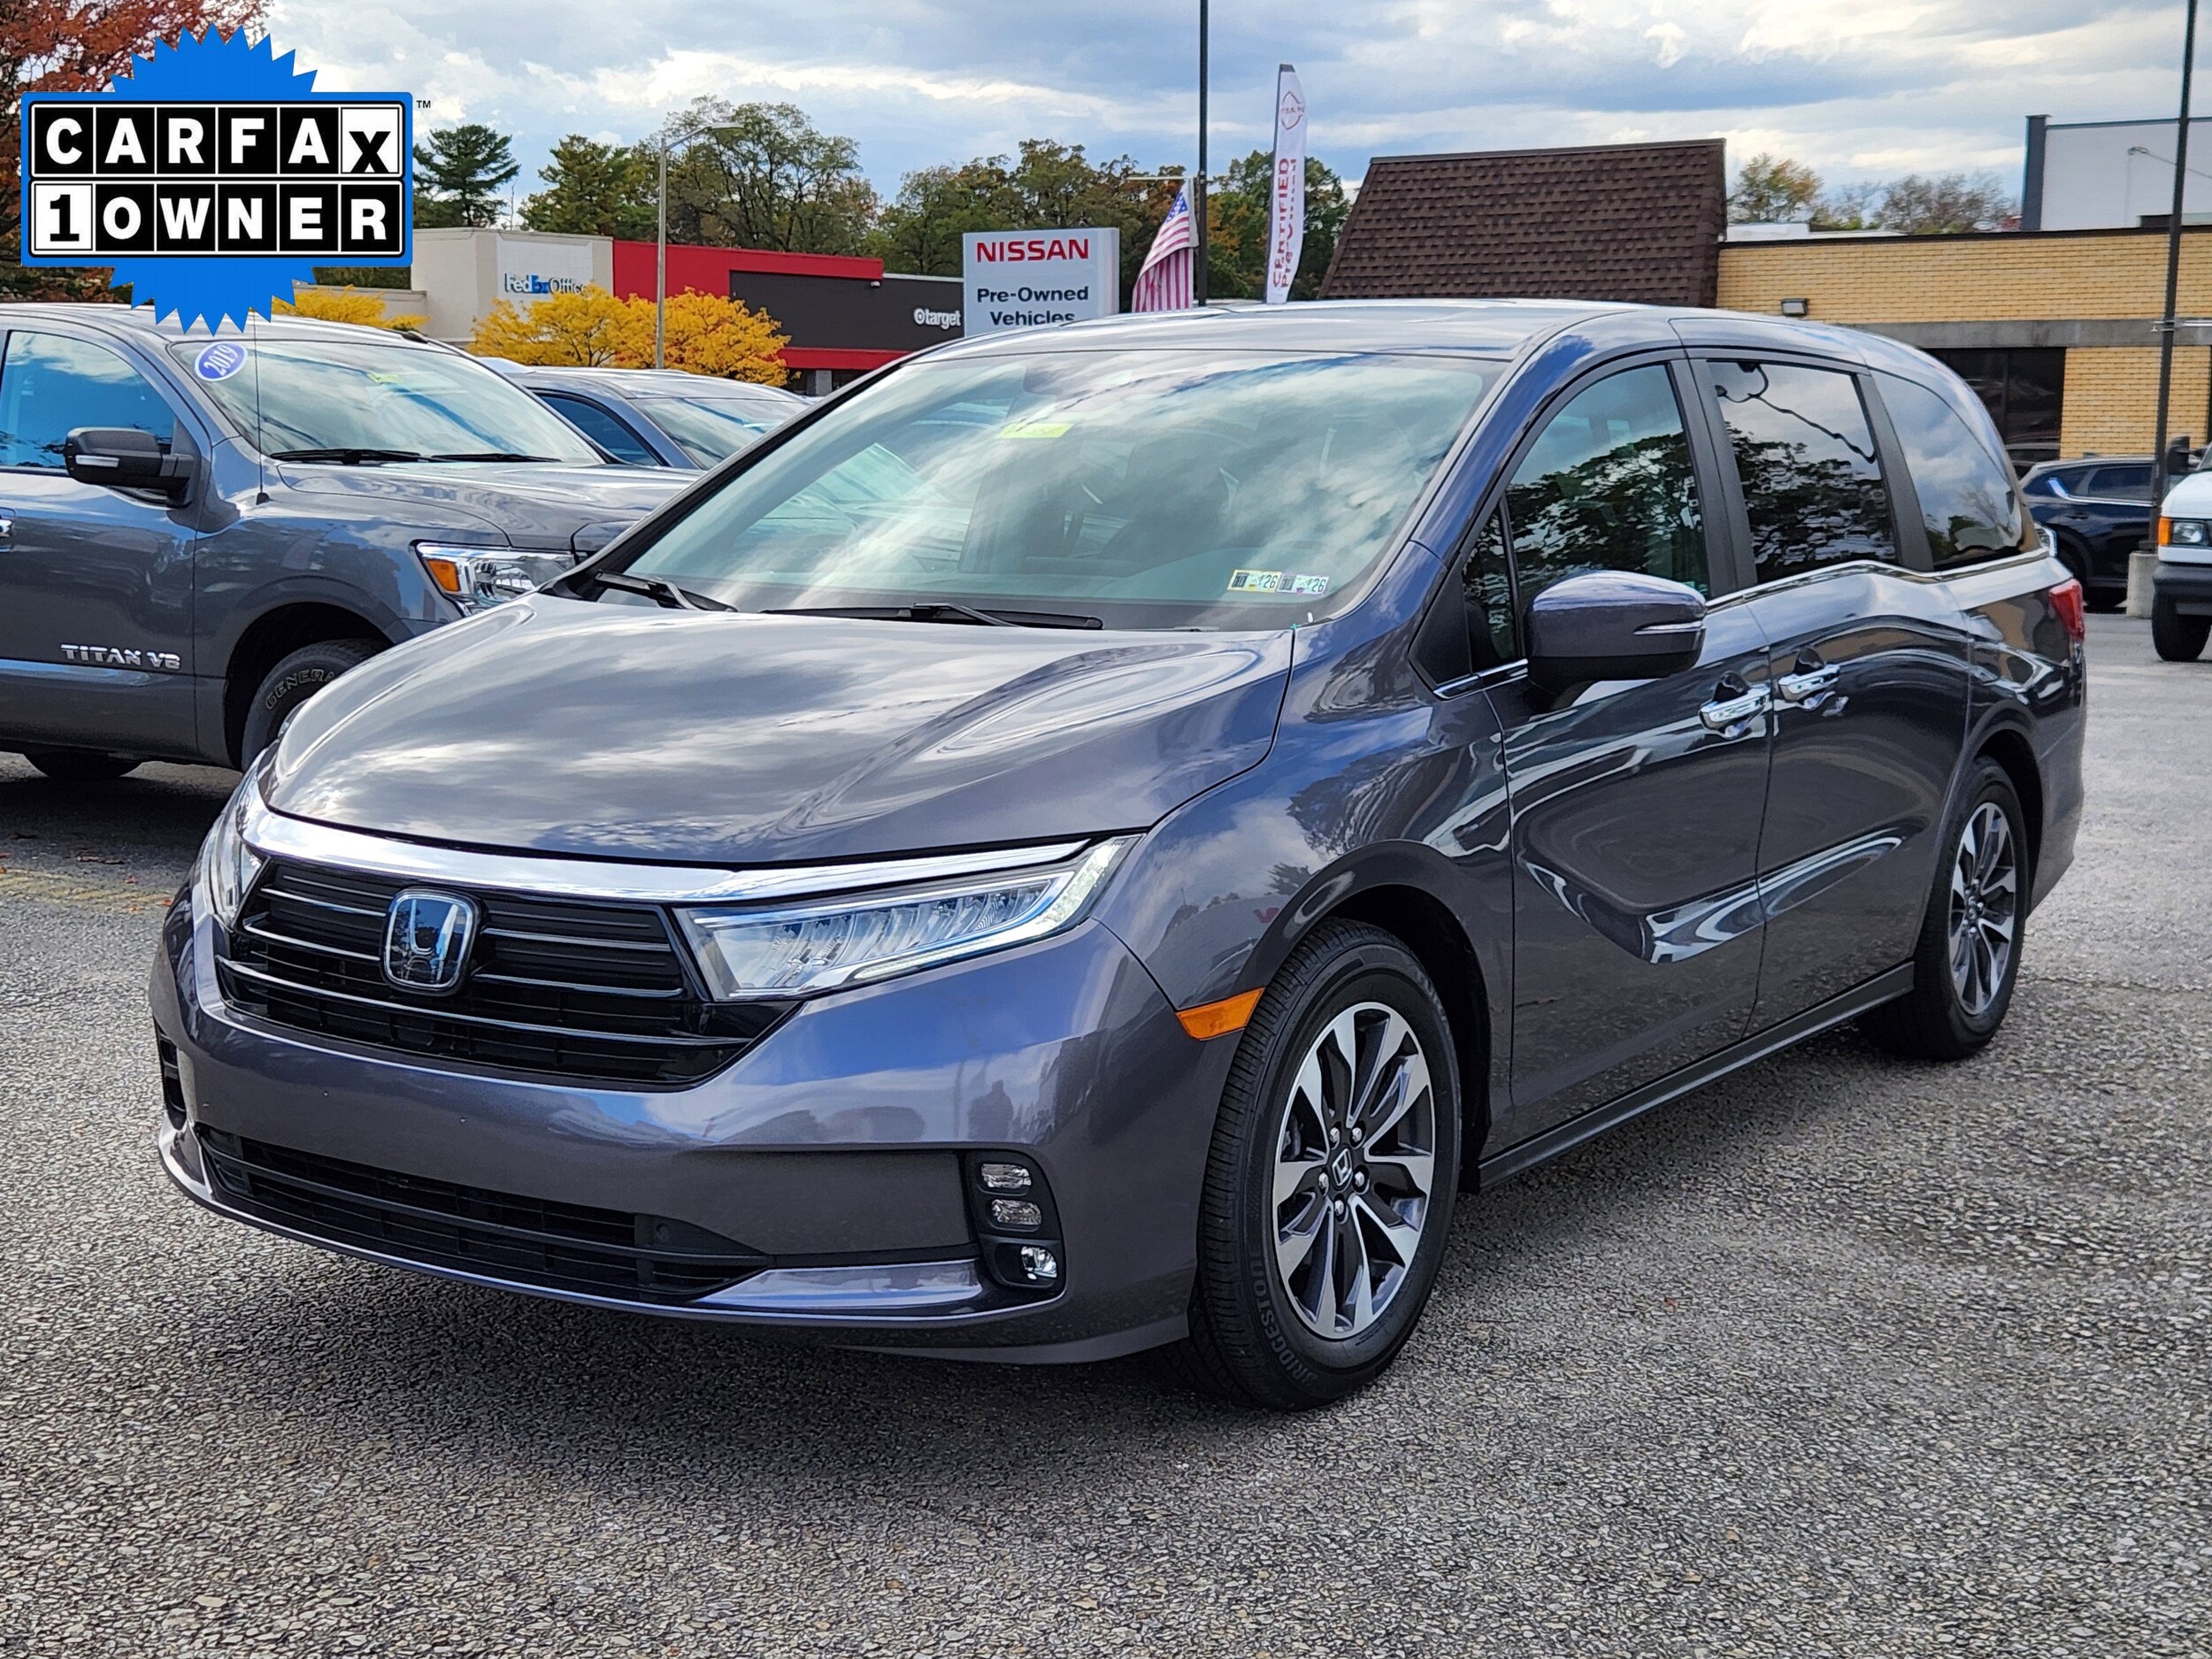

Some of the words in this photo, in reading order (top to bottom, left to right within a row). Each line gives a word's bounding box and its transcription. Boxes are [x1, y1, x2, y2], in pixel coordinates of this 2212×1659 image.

[977, 239, 1089, 263] NISSAN
[977, 286, 1089, 303] Pre-Owned
[925, 308, 962, 330] target
[989, 311, 1076, 326] Vehicles
[203, 344, 239, 377] 2019
[60, 644, 142, 666] TITAN
